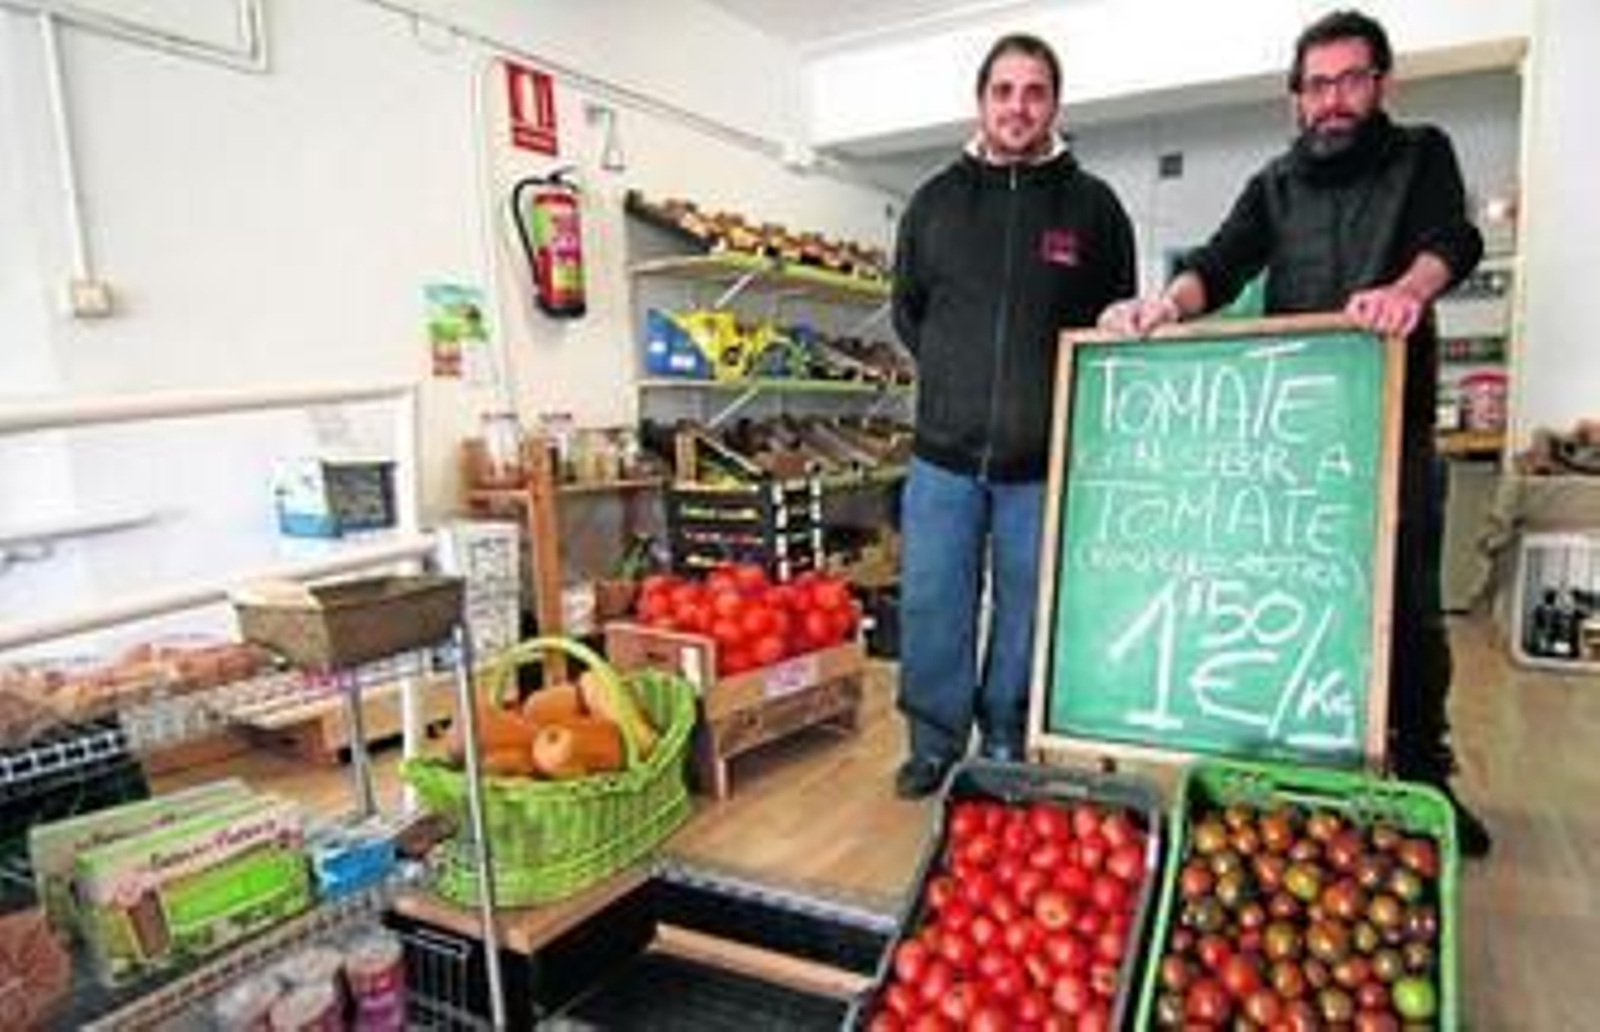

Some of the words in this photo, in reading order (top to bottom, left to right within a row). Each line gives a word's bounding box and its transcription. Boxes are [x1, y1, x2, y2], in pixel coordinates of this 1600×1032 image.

[1089, 341, 1337, 442] TOMATE
[1316, 442, 1352, 478] A
[1073, 480, 1353, 552] TOMATE
